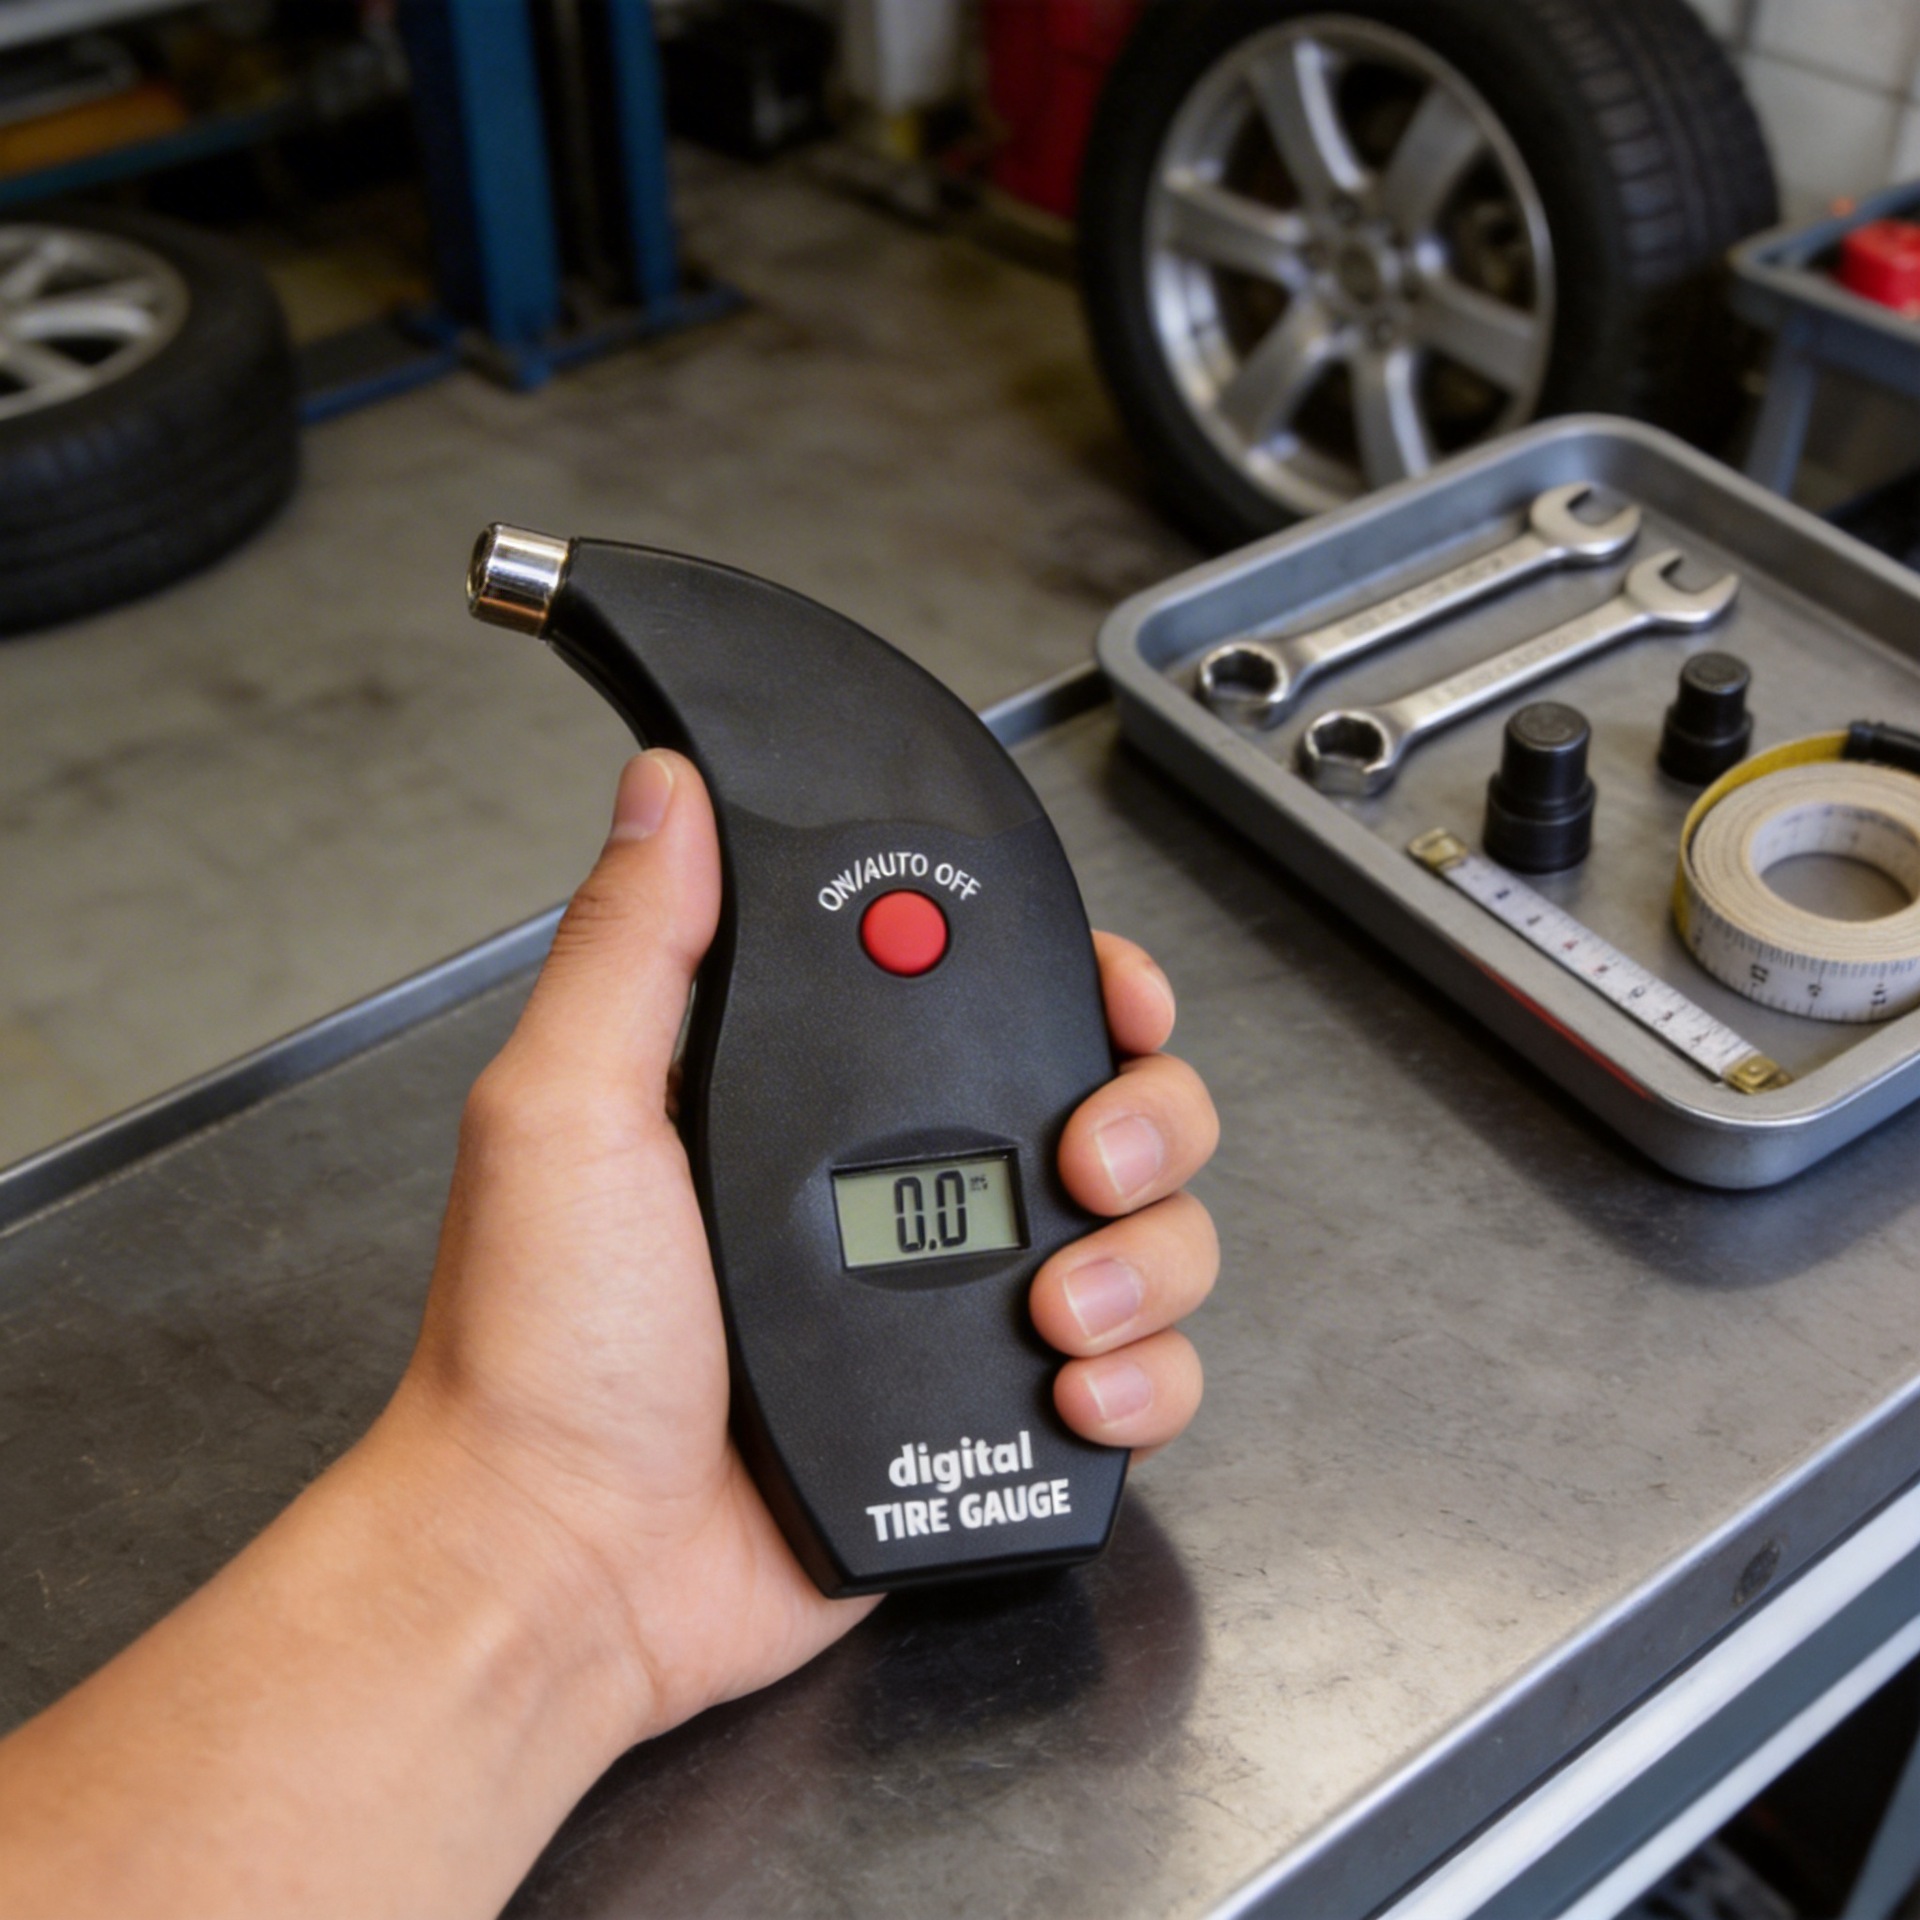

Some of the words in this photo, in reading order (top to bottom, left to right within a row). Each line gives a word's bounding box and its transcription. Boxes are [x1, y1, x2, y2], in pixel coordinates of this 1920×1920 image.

[818, 852, 928, 911] ON/AUTO
[934, 863, 981, 900] OFF
[894, 1170, 967, 1253] 0.0
[888, 1430, 1033, 1493] digital
[865, 1498, 950, 1542] TIRE
[958, 1478, 1072, 1529] GAUGE
